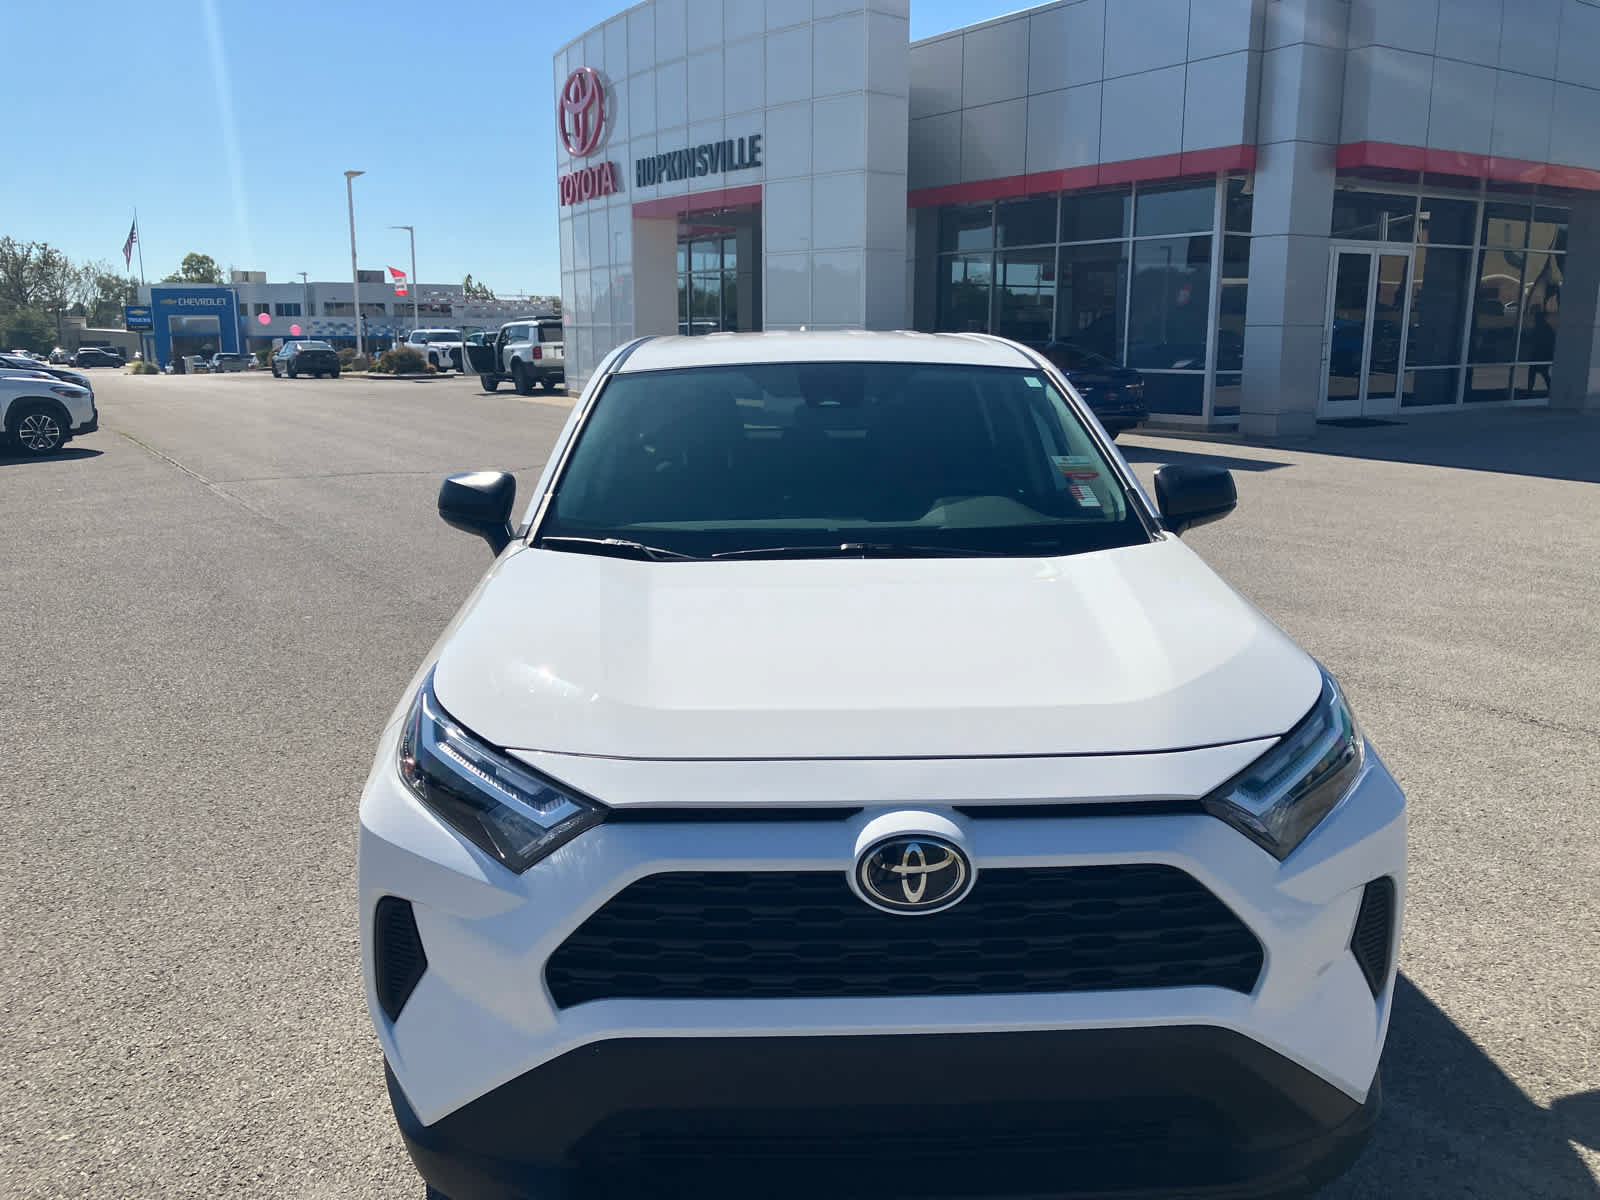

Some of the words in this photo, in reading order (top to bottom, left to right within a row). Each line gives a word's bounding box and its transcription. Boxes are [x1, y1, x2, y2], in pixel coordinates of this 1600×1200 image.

[558, 161, 618, 207] TOYOTA
[635, 134, 761, 188] HOPKINSVILLE
[177, 297, 226, 306] CHEVROLET
